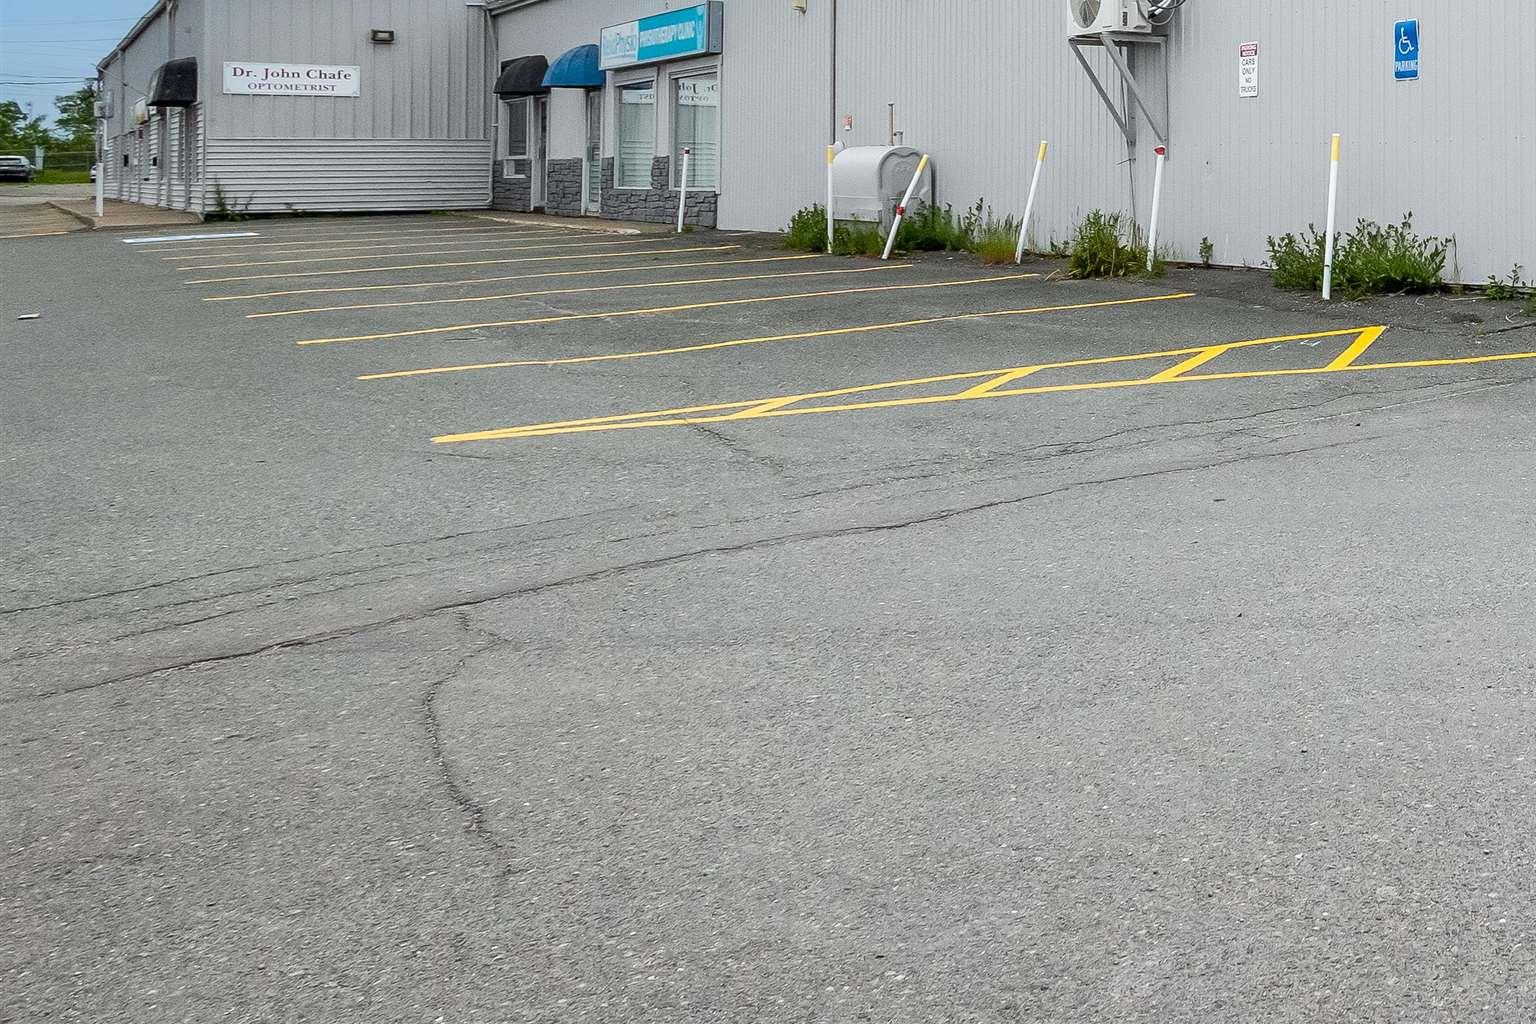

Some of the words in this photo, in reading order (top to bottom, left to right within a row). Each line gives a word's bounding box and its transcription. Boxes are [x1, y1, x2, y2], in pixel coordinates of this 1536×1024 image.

[1241, 57, 1256, 67] CARS
[1394, 59, 1418, 72] PARKING
[231, 66, 257, 78] Dr.
[261, 67, 301, 81] John
[306, 68, 352, 81] Chafe
[1241, 67, 1256, 76] ONLY
[247, 81, 337, 93] OPTOMETRIST
[1240, 85, 1257, 94] TRUCKS
